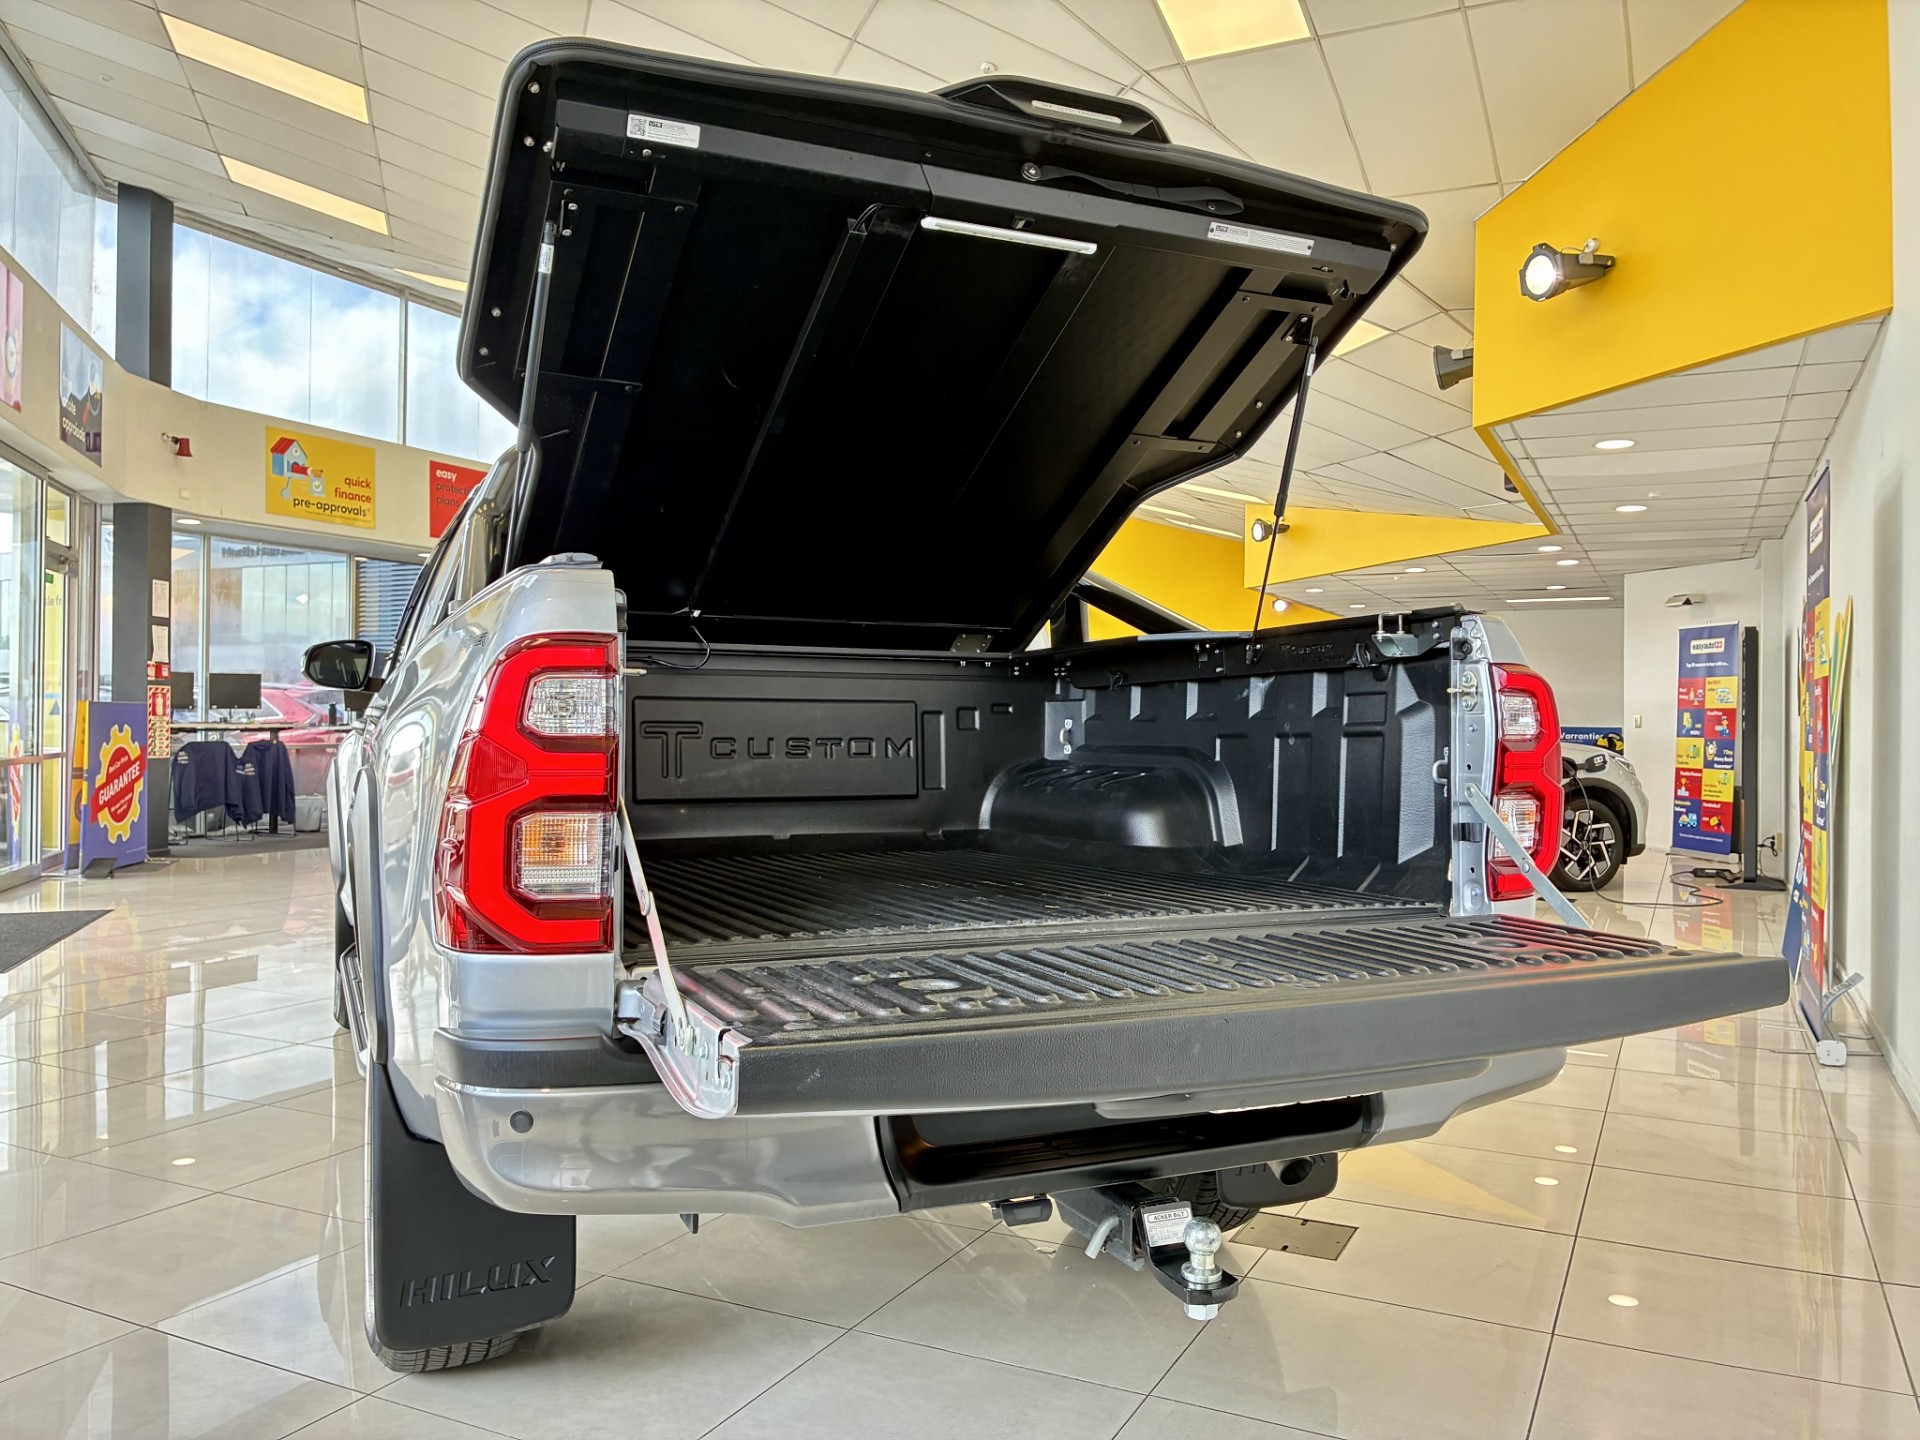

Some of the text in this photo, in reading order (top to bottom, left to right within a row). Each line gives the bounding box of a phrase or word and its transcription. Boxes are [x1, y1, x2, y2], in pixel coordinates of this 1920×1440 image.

[344, 476, 371, 490] quick
[435, 469, 458, 483] easy
[334, 486, 372, 504] finance
[436, 483, 470, 497] protecti
[1691, 640, 1723, 651] easyauto123
[709, 736, 915, 760] CUSTOM
[98, 760, 141, 806] GUARANTEE
[399, 1255, 556, 1309] HILUX
